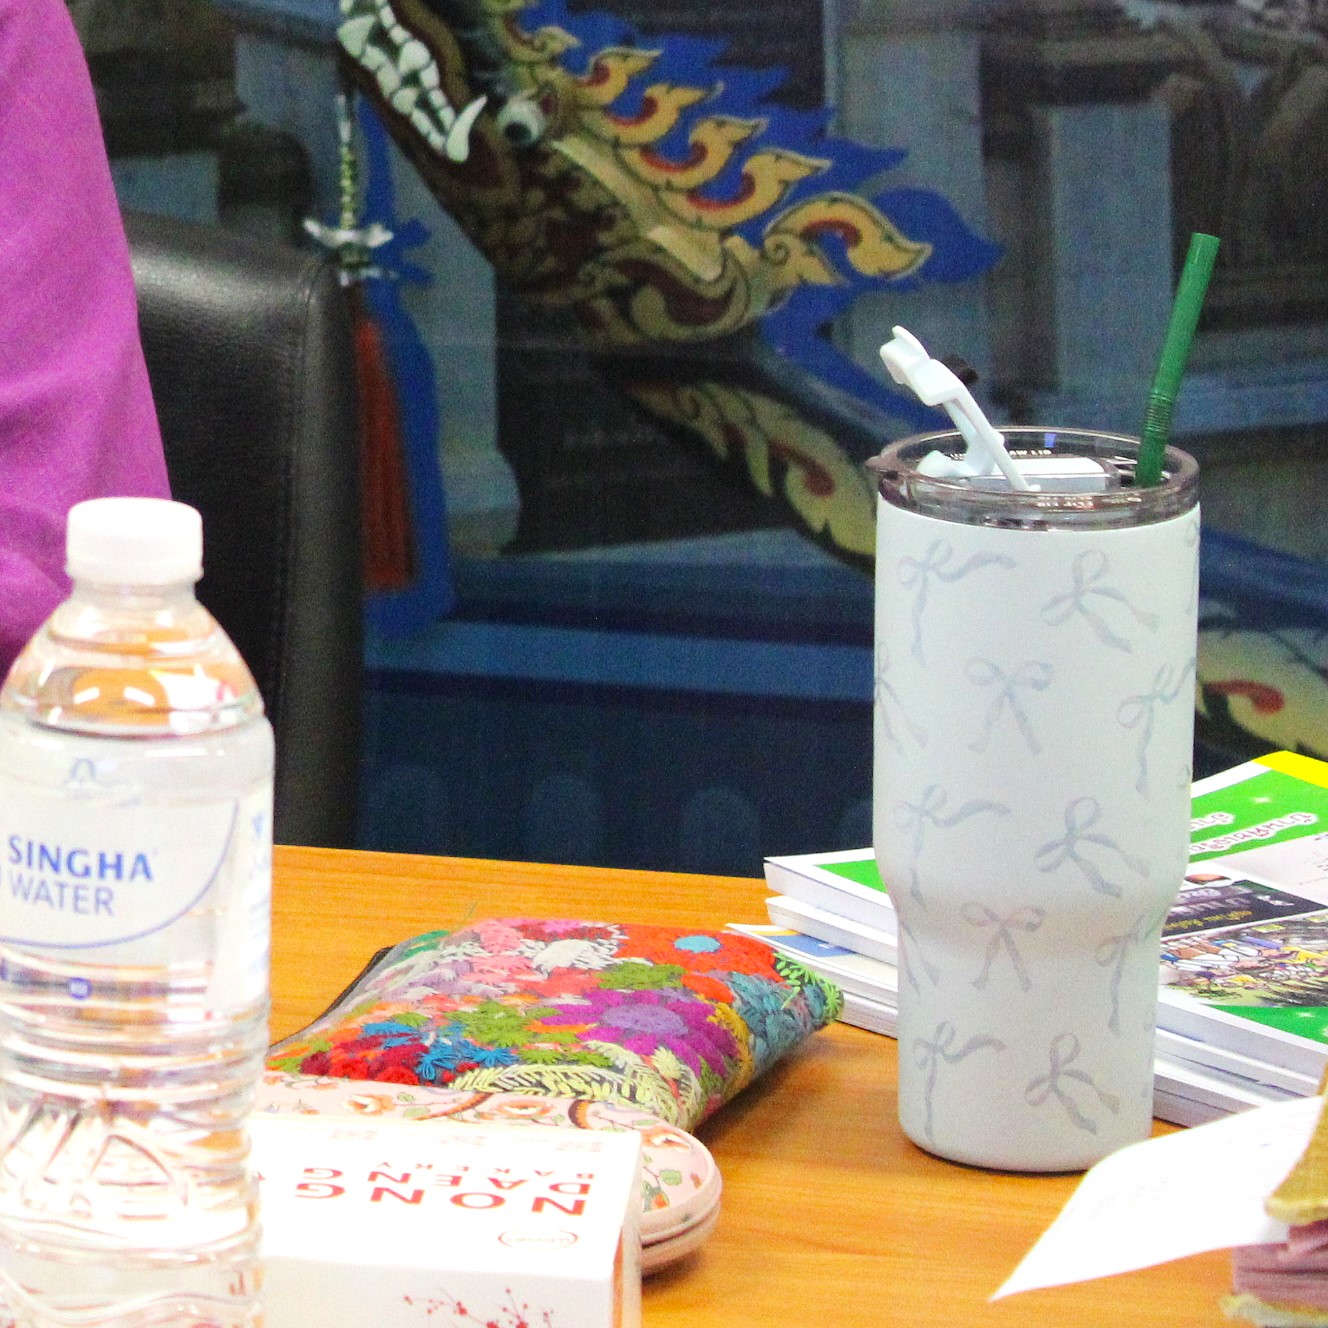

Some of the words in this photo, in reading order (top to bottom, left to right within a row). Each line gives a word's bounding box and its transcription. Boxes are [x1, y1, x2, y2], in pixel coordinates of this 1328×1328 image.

[8, 836, 155, 883] SINGHA
[8, 877, 115, 918] WATER
[301, 1167, 592, 1196] DAENG
[376, 1161, 595, 1180] BAKERY
[295, 1182, 587, 1216] NONG
